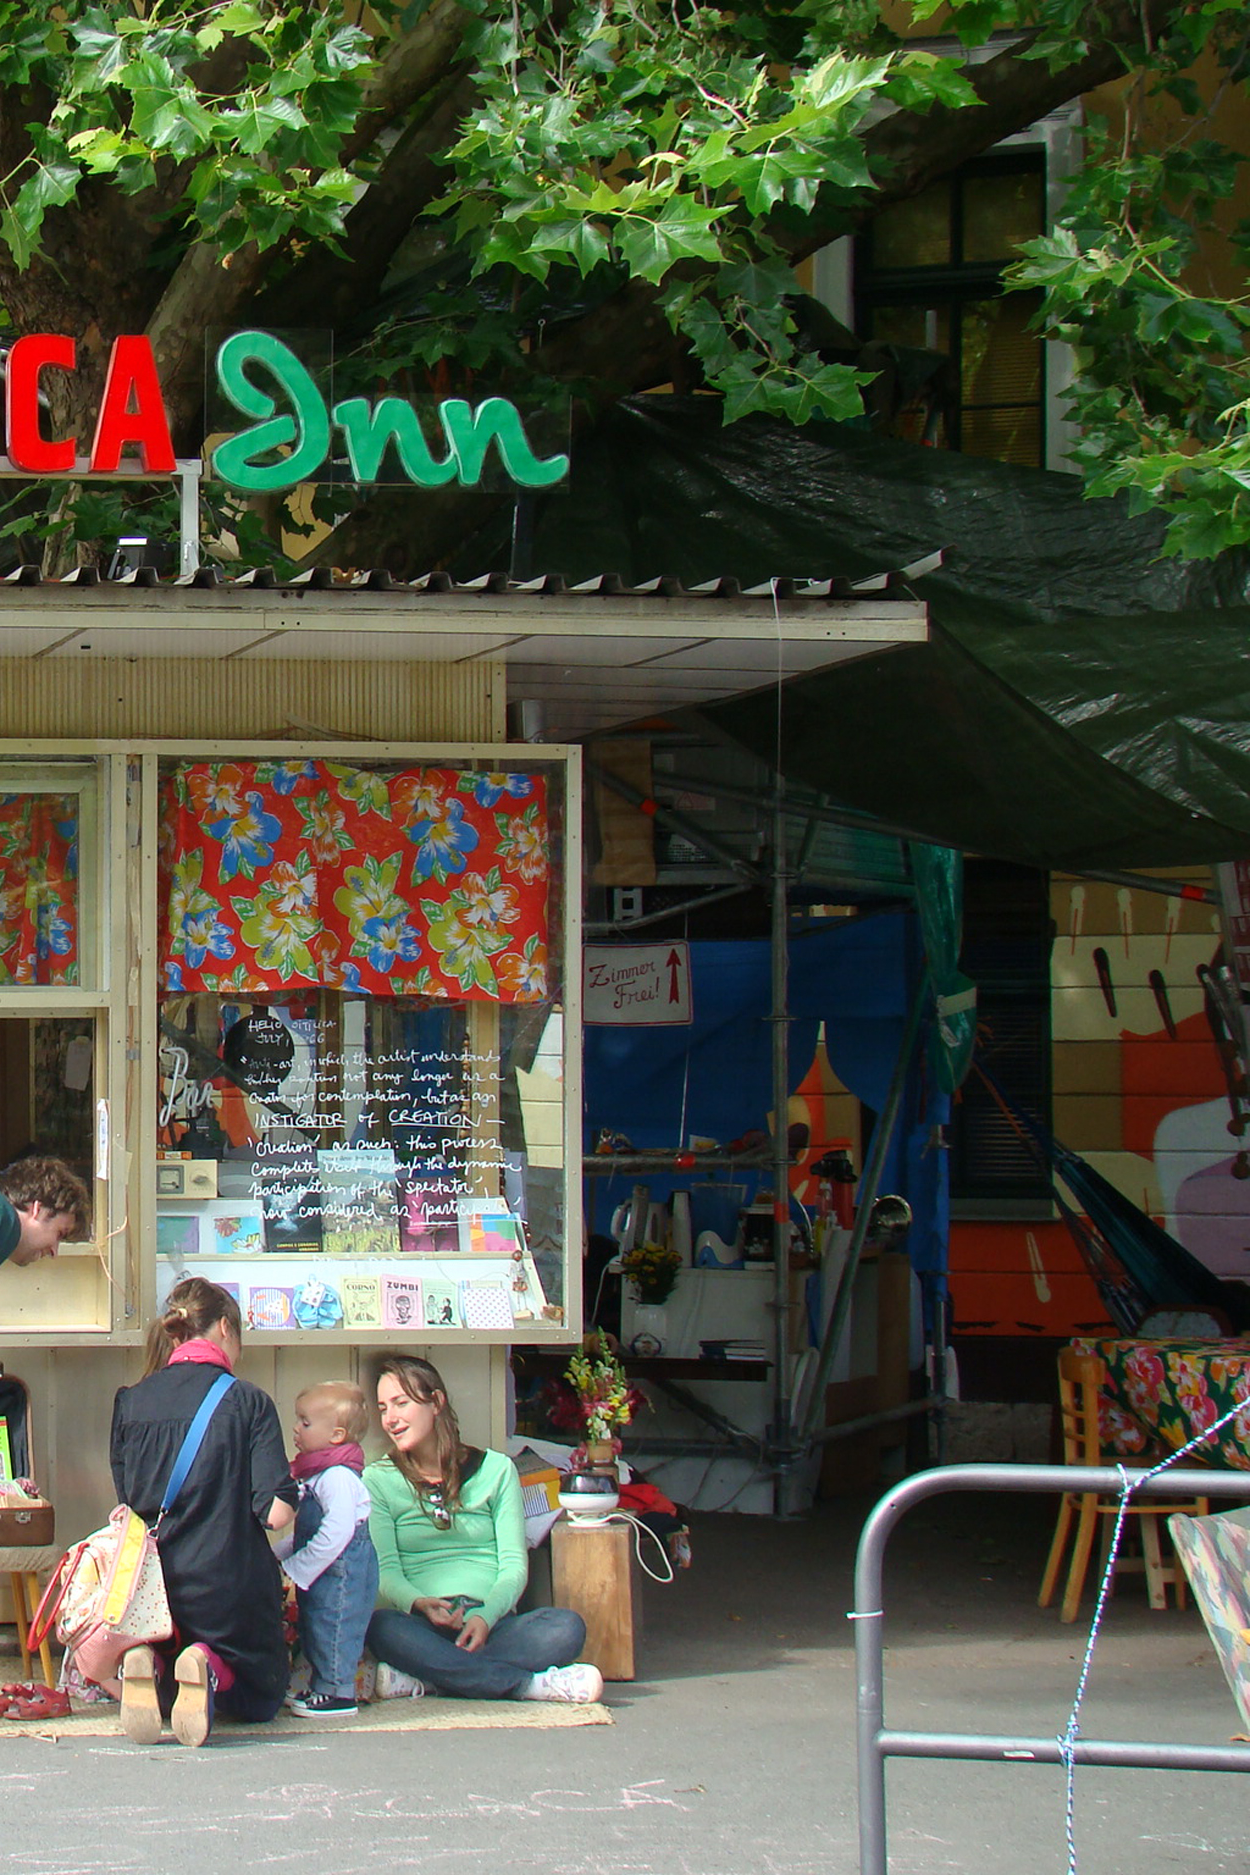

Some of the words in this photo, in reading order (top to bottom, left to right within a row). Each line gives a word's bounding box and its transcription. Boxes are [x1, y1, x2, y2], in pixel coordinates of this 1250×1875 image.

[211, 330, 570, 492] Inn
[588, 961, 656, 989] Zimmer
[613, 976, 660, 1009] Frei!
[377, 1048, 421, 1064] artist
[159, 1046, 214, 1127] Bar
[342, 1070, 369, 1083] not
[371, 1072, 405, 1086] any
[489, 1072, 506, 1081] a
[421, 1087, 448, 1104] but
[254, 1111, 348, 1129] INSTIGATOR
[357, 1112, 381, 1128] of
[388, 1109, 483, 1128] CREATION
[405, 1133, 437, 1152] this
[441, 1137, 504, 1156] process
[424, 1156, 444, 1171] the
[368, 1180, 395, 1199] the
[386, 1280, 419, 1292] ZUMBI
